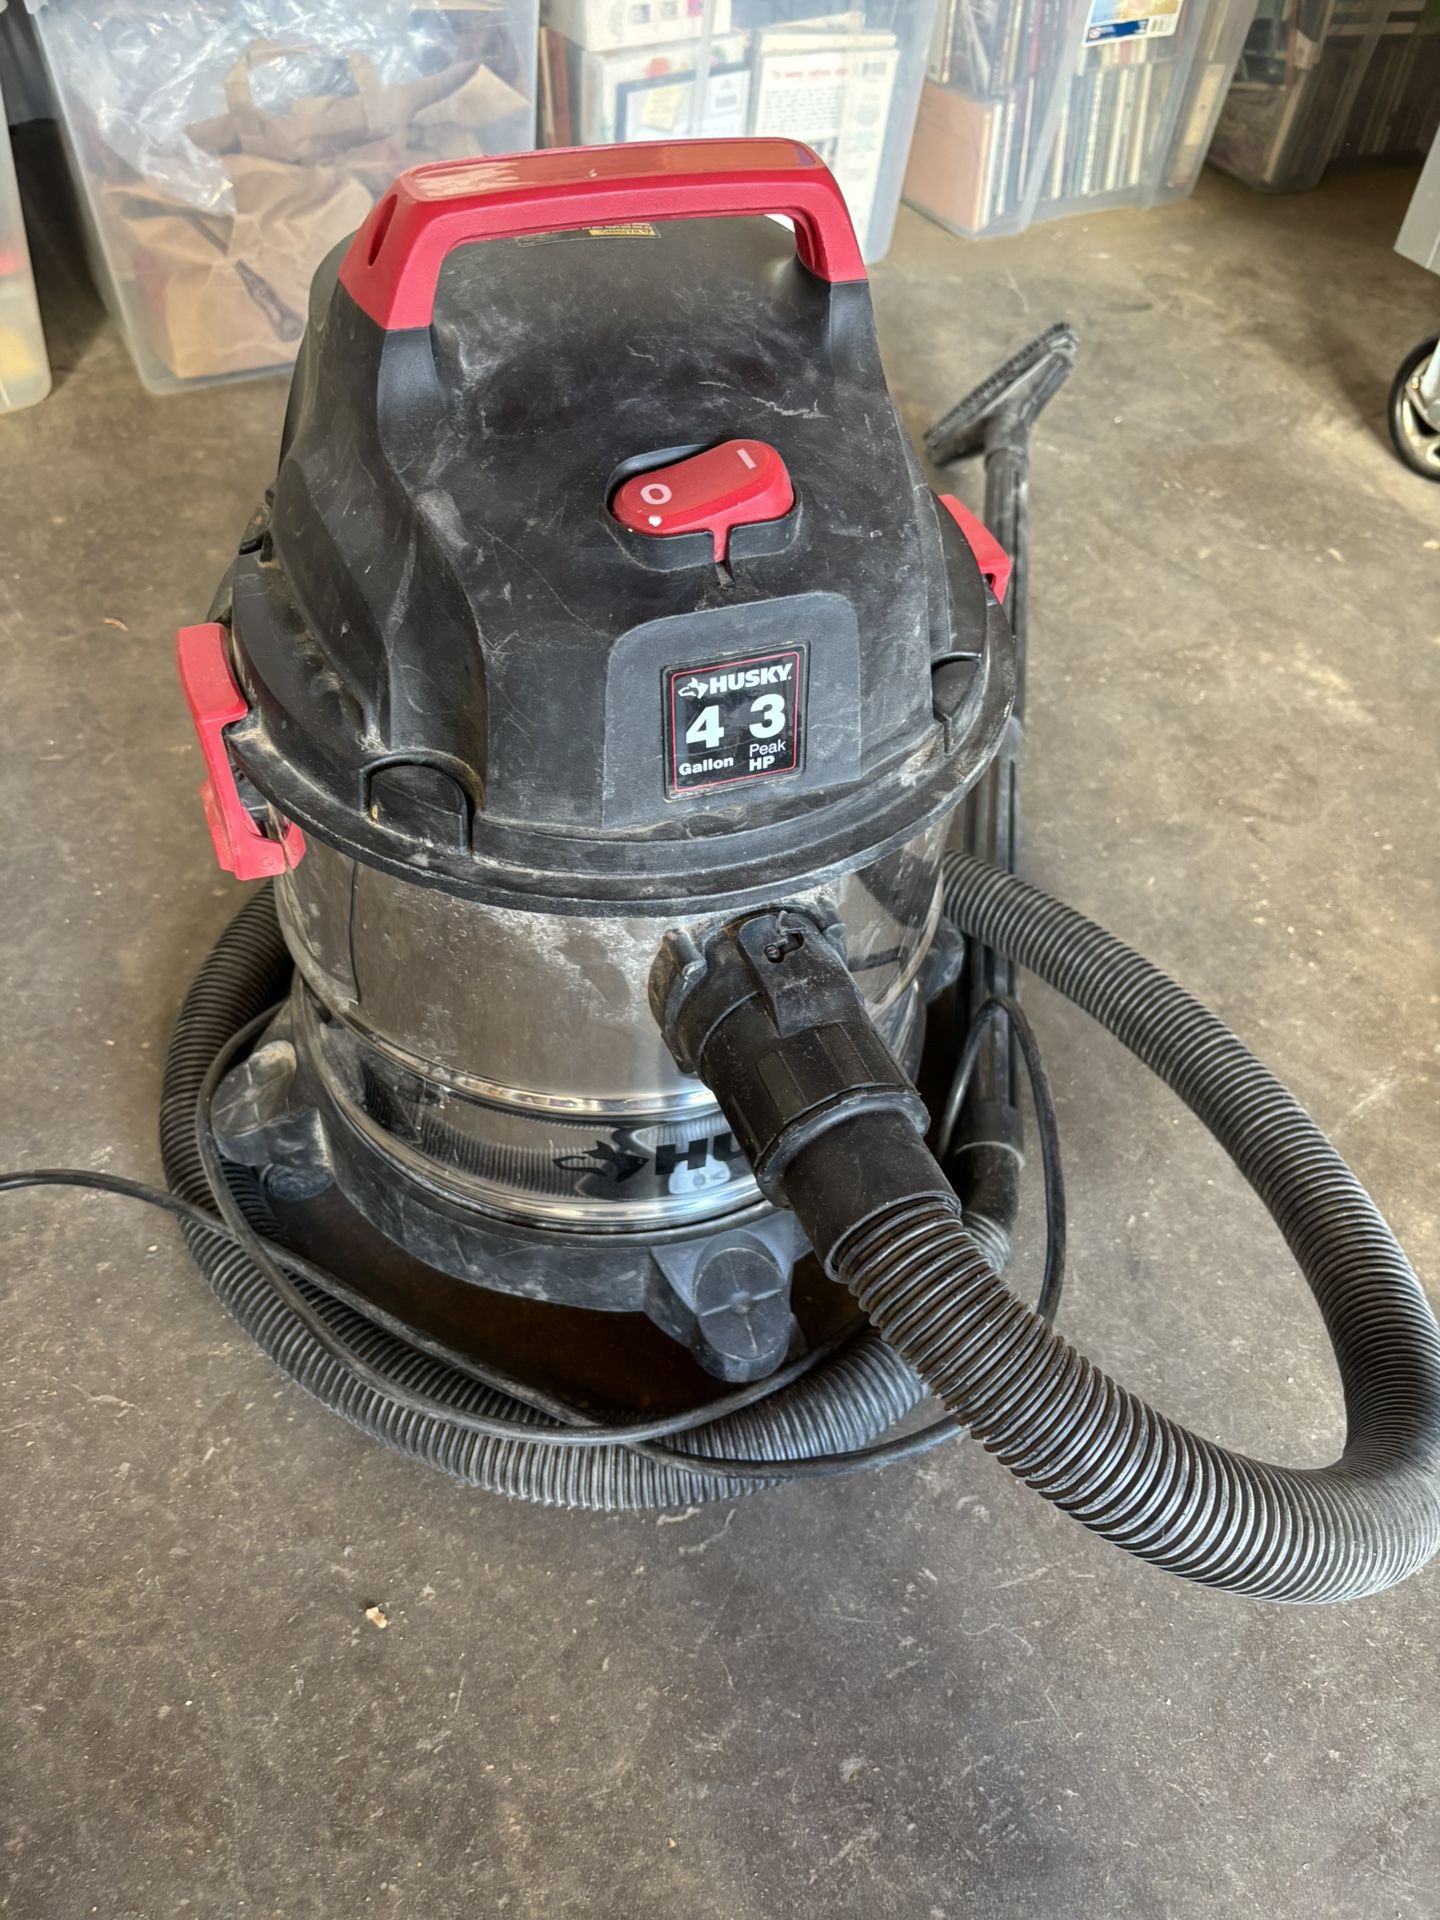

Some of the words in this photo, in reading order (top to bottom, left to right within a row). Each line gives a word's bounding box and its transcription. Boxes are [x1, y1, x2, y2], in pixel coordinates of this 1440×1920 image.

[686, 705, 725, 749] 4
[749, 693, 786, 739] 3
[749, 739, 786, 757] Peak
[678, 757, 734, 776] Gallon
[749, 755, 775, 772] HP
